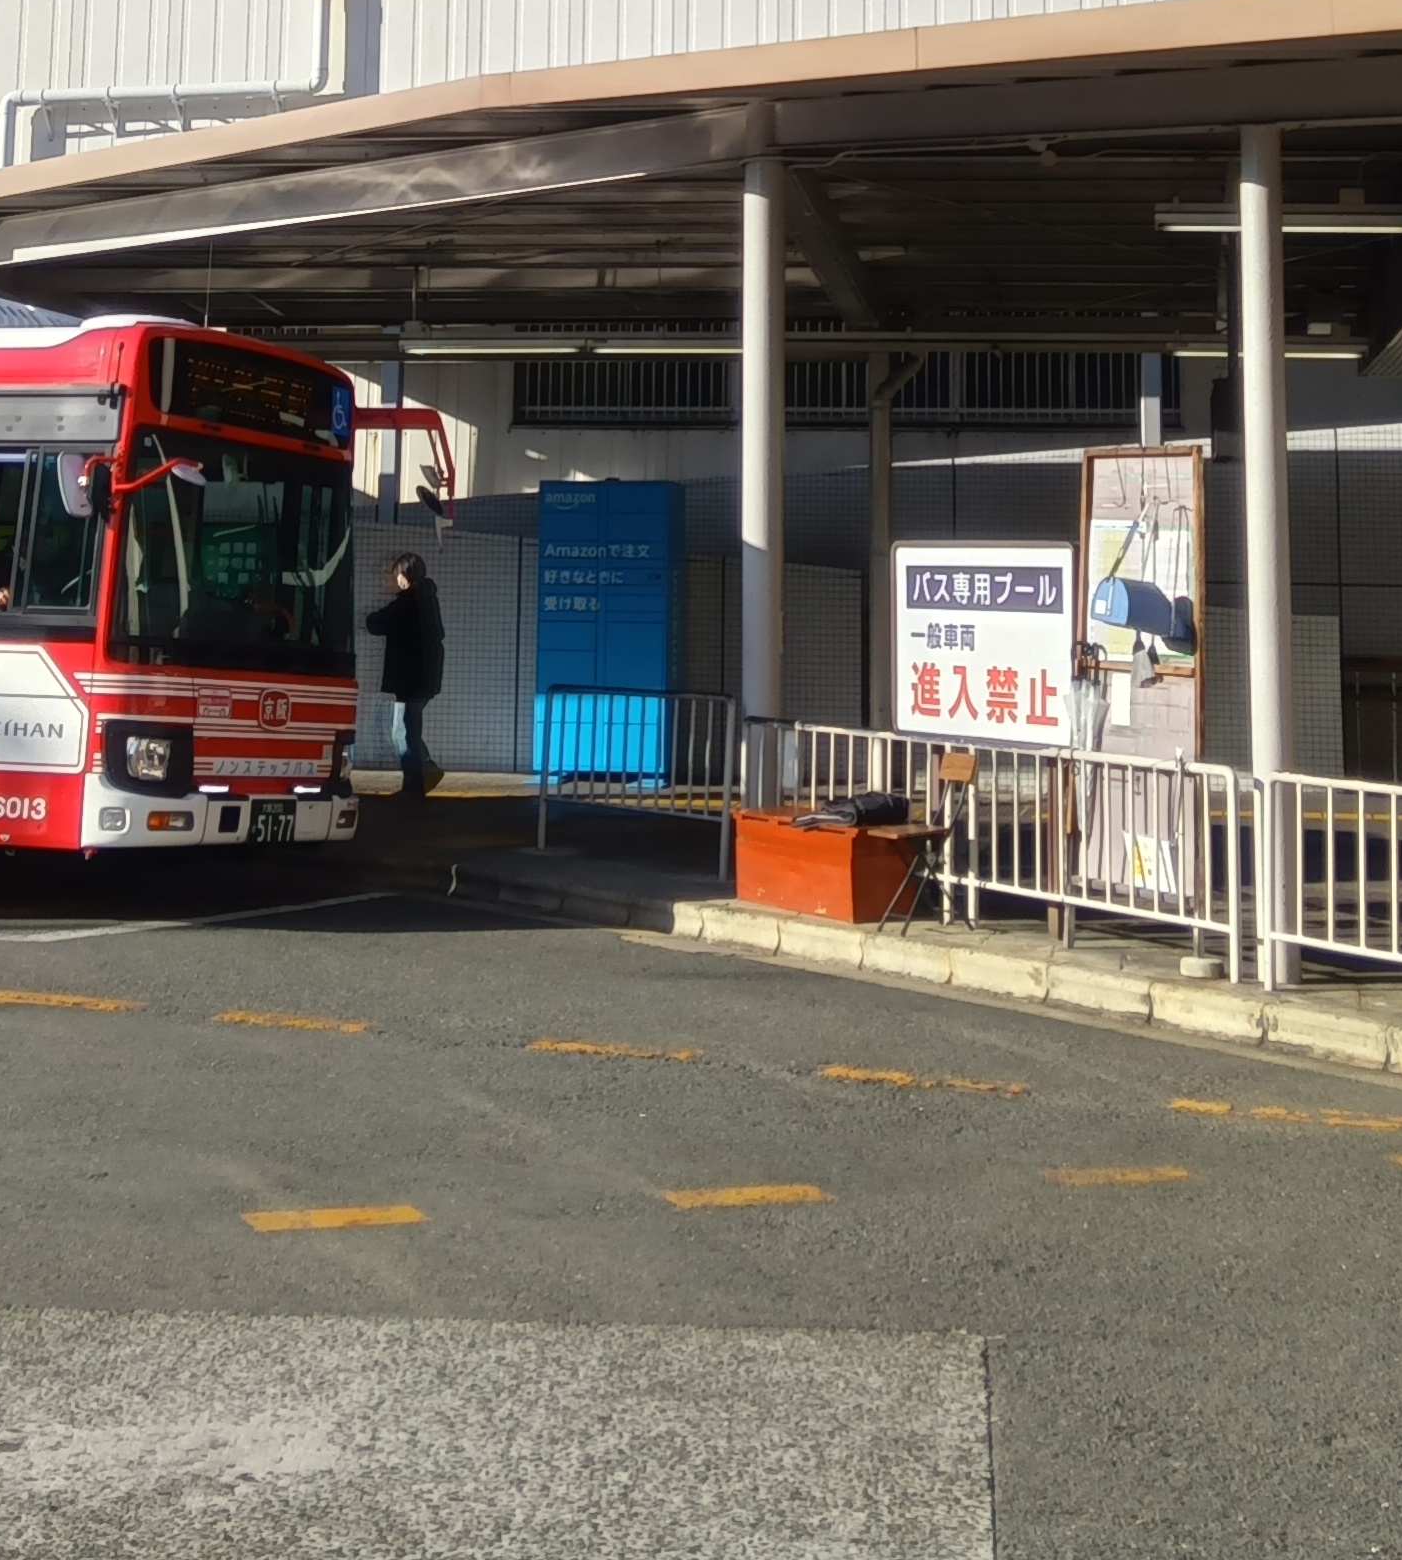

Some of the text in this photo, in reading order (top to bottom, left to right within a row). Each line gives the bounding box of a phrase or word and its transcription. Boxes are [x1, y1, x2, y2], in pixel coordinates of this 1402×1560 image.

[544, 491, 596, 504] amazon
[544, 542, 651, 559] Amazonで注文
[543, 569, 625, 585] 好きなときに
[911, 570, 1057, 607] バス専用プール
[543, 595, 601, 612] 受け取る
[910, 621, 976, 652] 一般車両
[910, 661, 1059, 727] 進入禁止
[263, 697, 288, 721] 京阪
[215, 760, 318, 775] ノンステップバス
